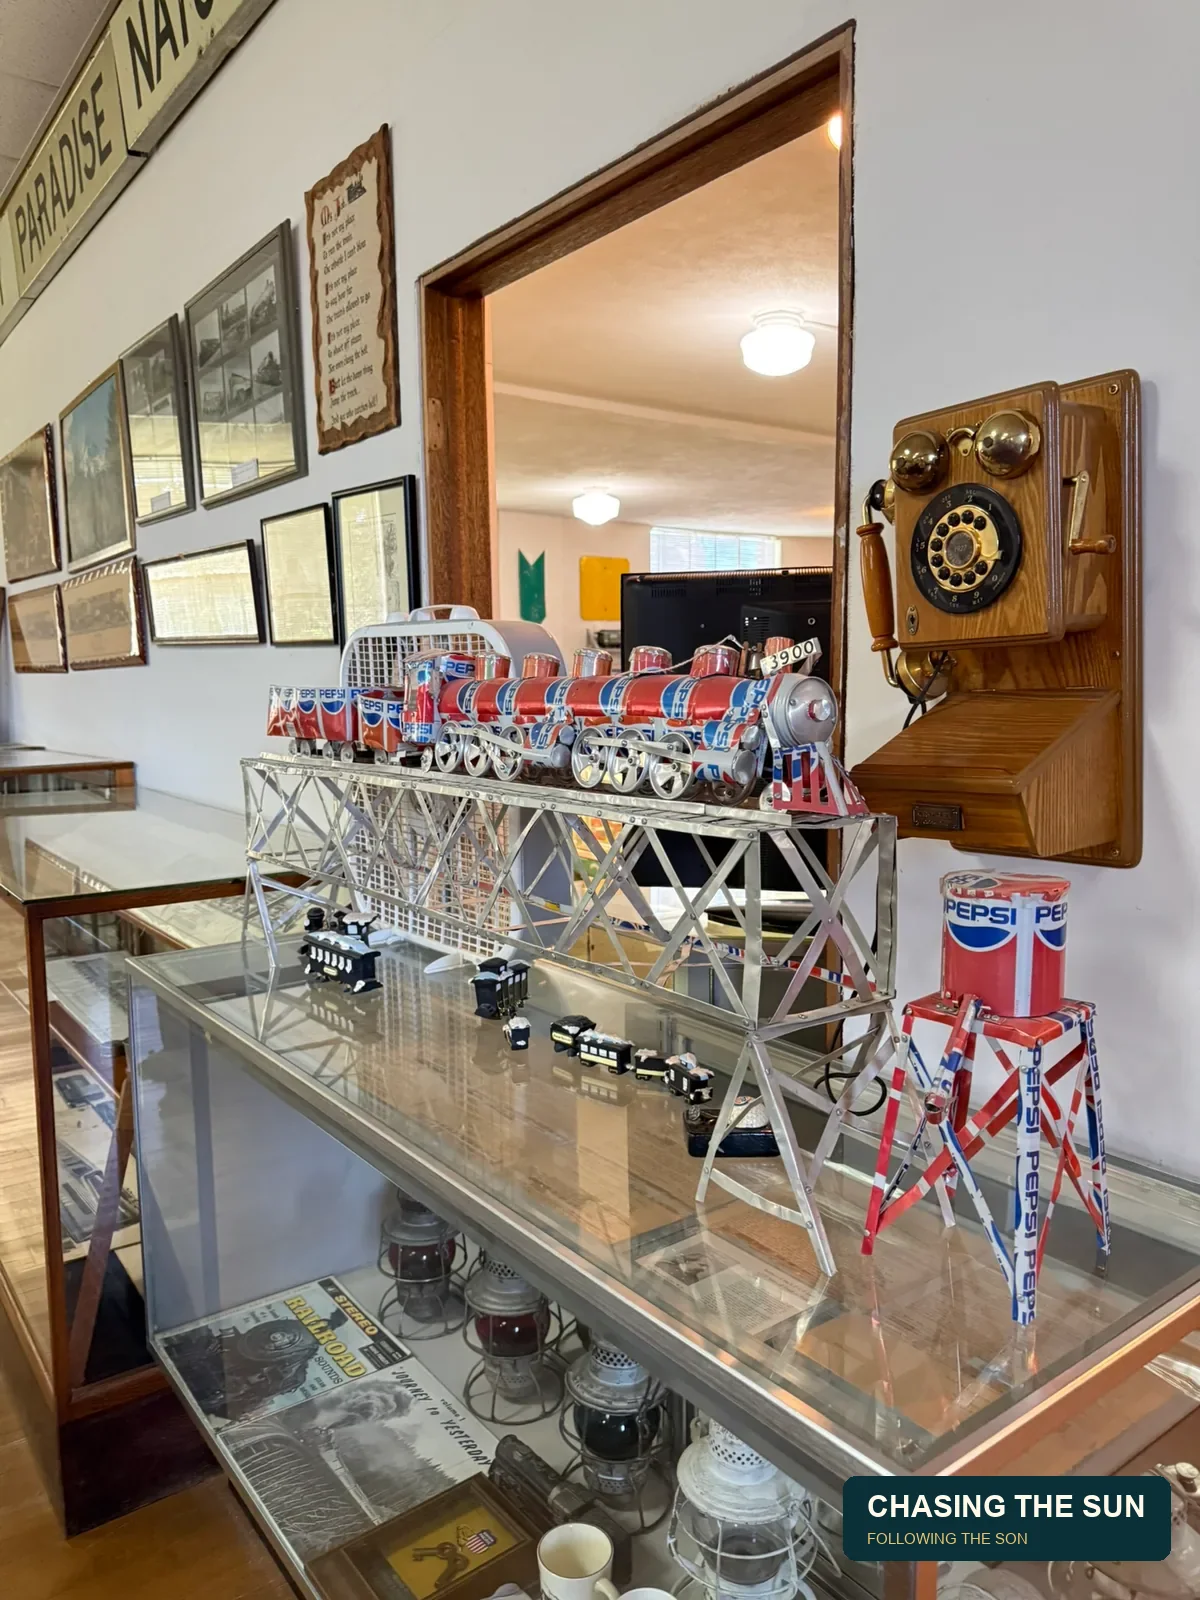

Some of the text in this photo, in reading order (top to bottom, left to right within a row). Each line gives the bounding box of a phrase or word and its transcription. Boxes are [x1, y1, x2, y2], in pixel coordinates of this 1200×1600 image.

[126, 0, 214, 110] NA
[15, 72, 112, 274] PARADISE
[770, 640, 814, 670] 3900
[945, 899, 1017, 926] PEPSI
[1026, 1044, 1041, 1134] PEPSI
[1025, 1150, 1040, 1239] PEPSI
[284, 1295, 367, 1379] RAILROAD
[334, 1294, 379, 1336] STEREO
[314, 1355, 344, 1385] SOUNDS
[440, 1398, 461, 1418] volume
[440, 1419, 494, 1466] YESTERDAY
